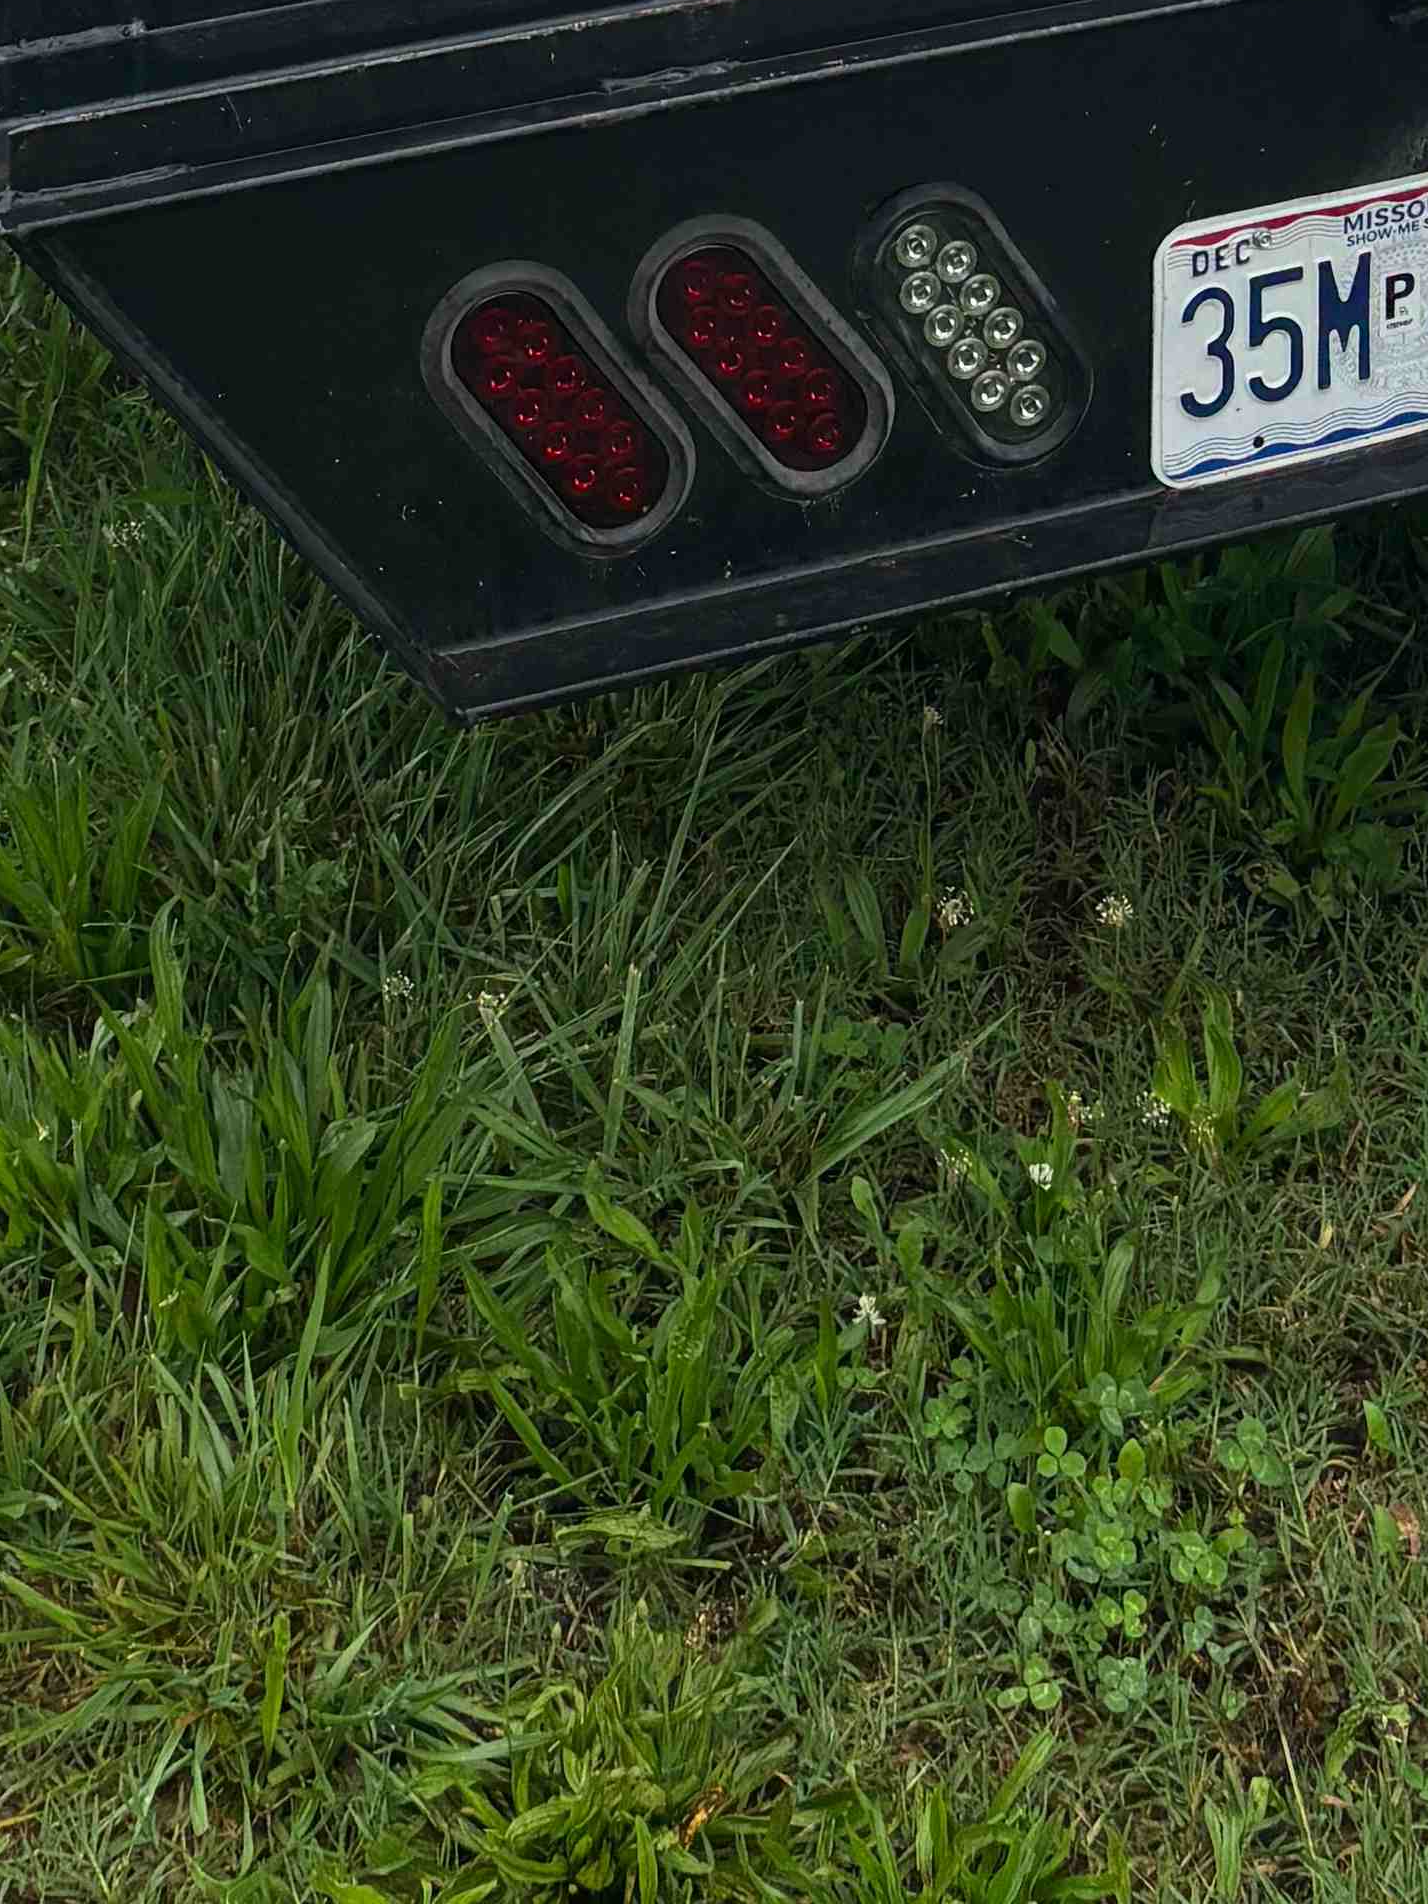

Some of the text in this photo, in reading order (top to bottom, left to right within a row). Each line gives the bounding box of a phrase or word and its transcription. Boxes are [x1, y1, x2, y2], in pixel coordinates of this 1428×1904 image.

[1347, 221, 1419, 247] SHOW-ME
[1191, 237, 1251, 277] DEC
[1386, 273, 1415, 320] P
[1180, 251, 1371, 419] 35M
